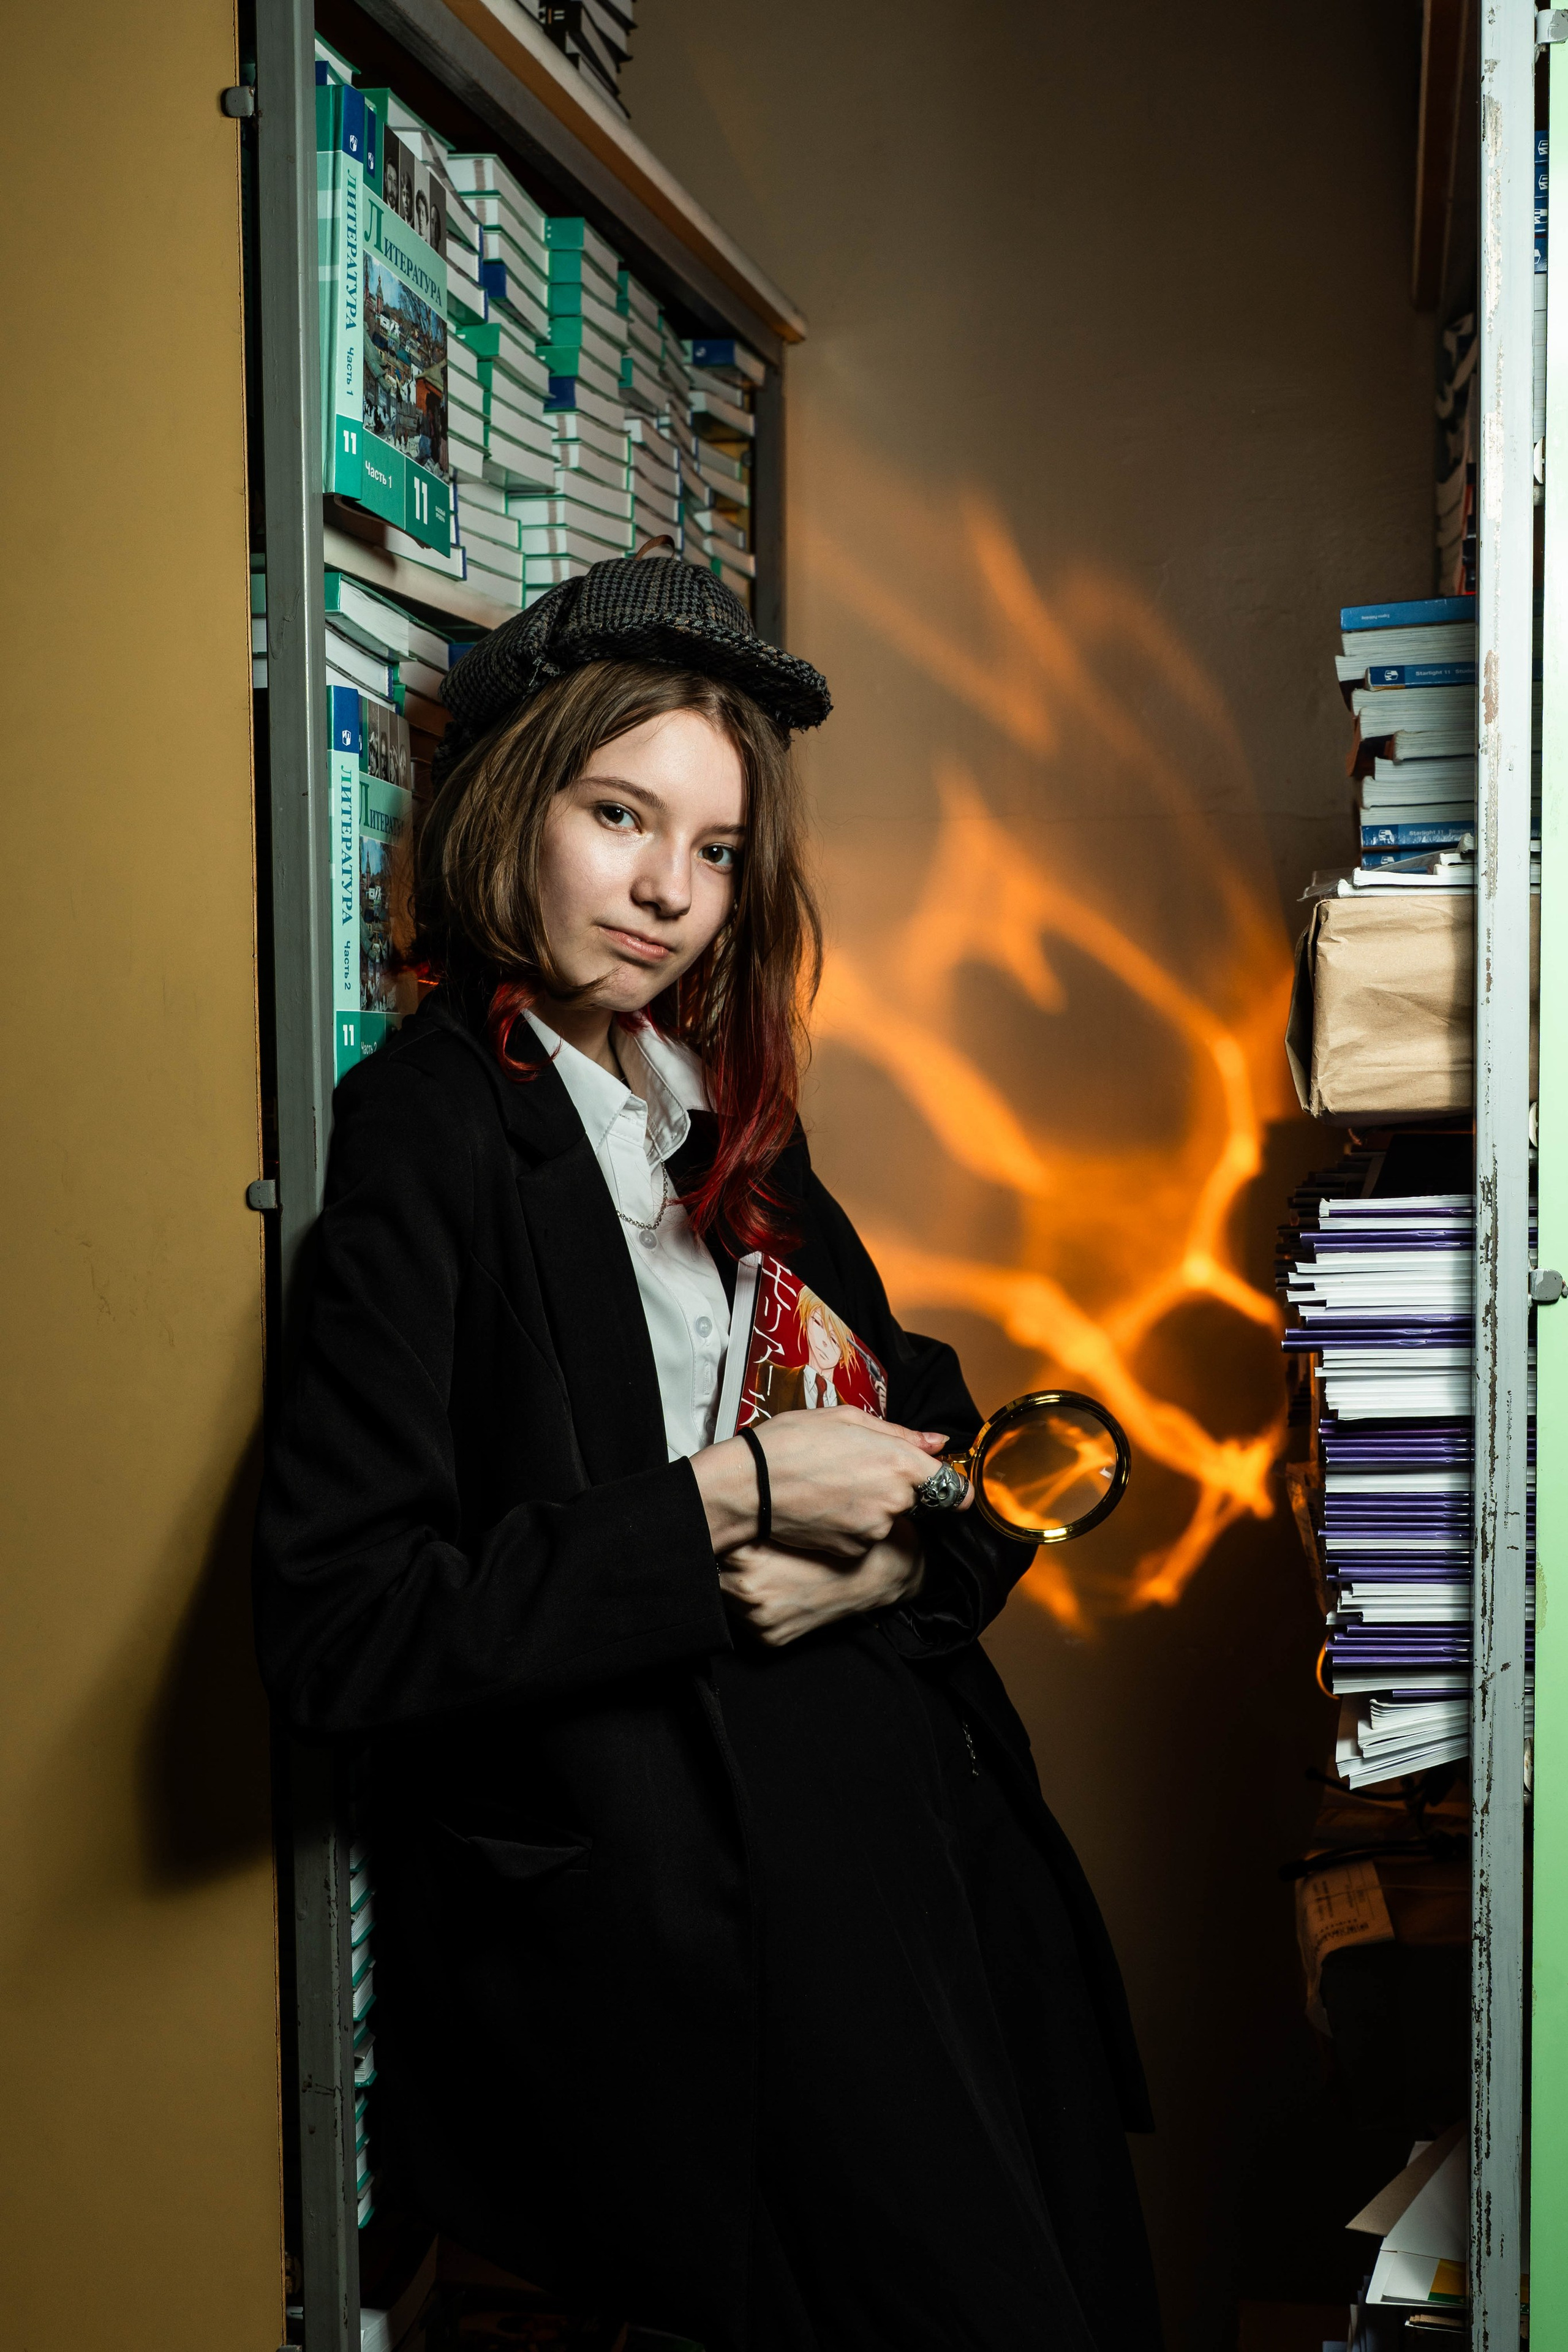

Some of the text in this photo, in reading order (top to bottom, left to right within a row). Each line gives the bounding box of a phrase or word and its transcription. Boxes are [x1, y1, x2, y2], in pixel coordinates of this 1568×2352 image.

[346, 169, 358, 331] ЛИТЕРАТУРА
[343, 430, 356, 454] 11
[365, 460, 392, 488] Часть 1
[414, 477, 428, 525] 11
[341, 765, 353, 926] ЛИТЕРАТУРА
[344, 982, 351, 990] 2
[343, 1024, 354, 1046] 11
[361, 1041, 374, 1055] Часть
